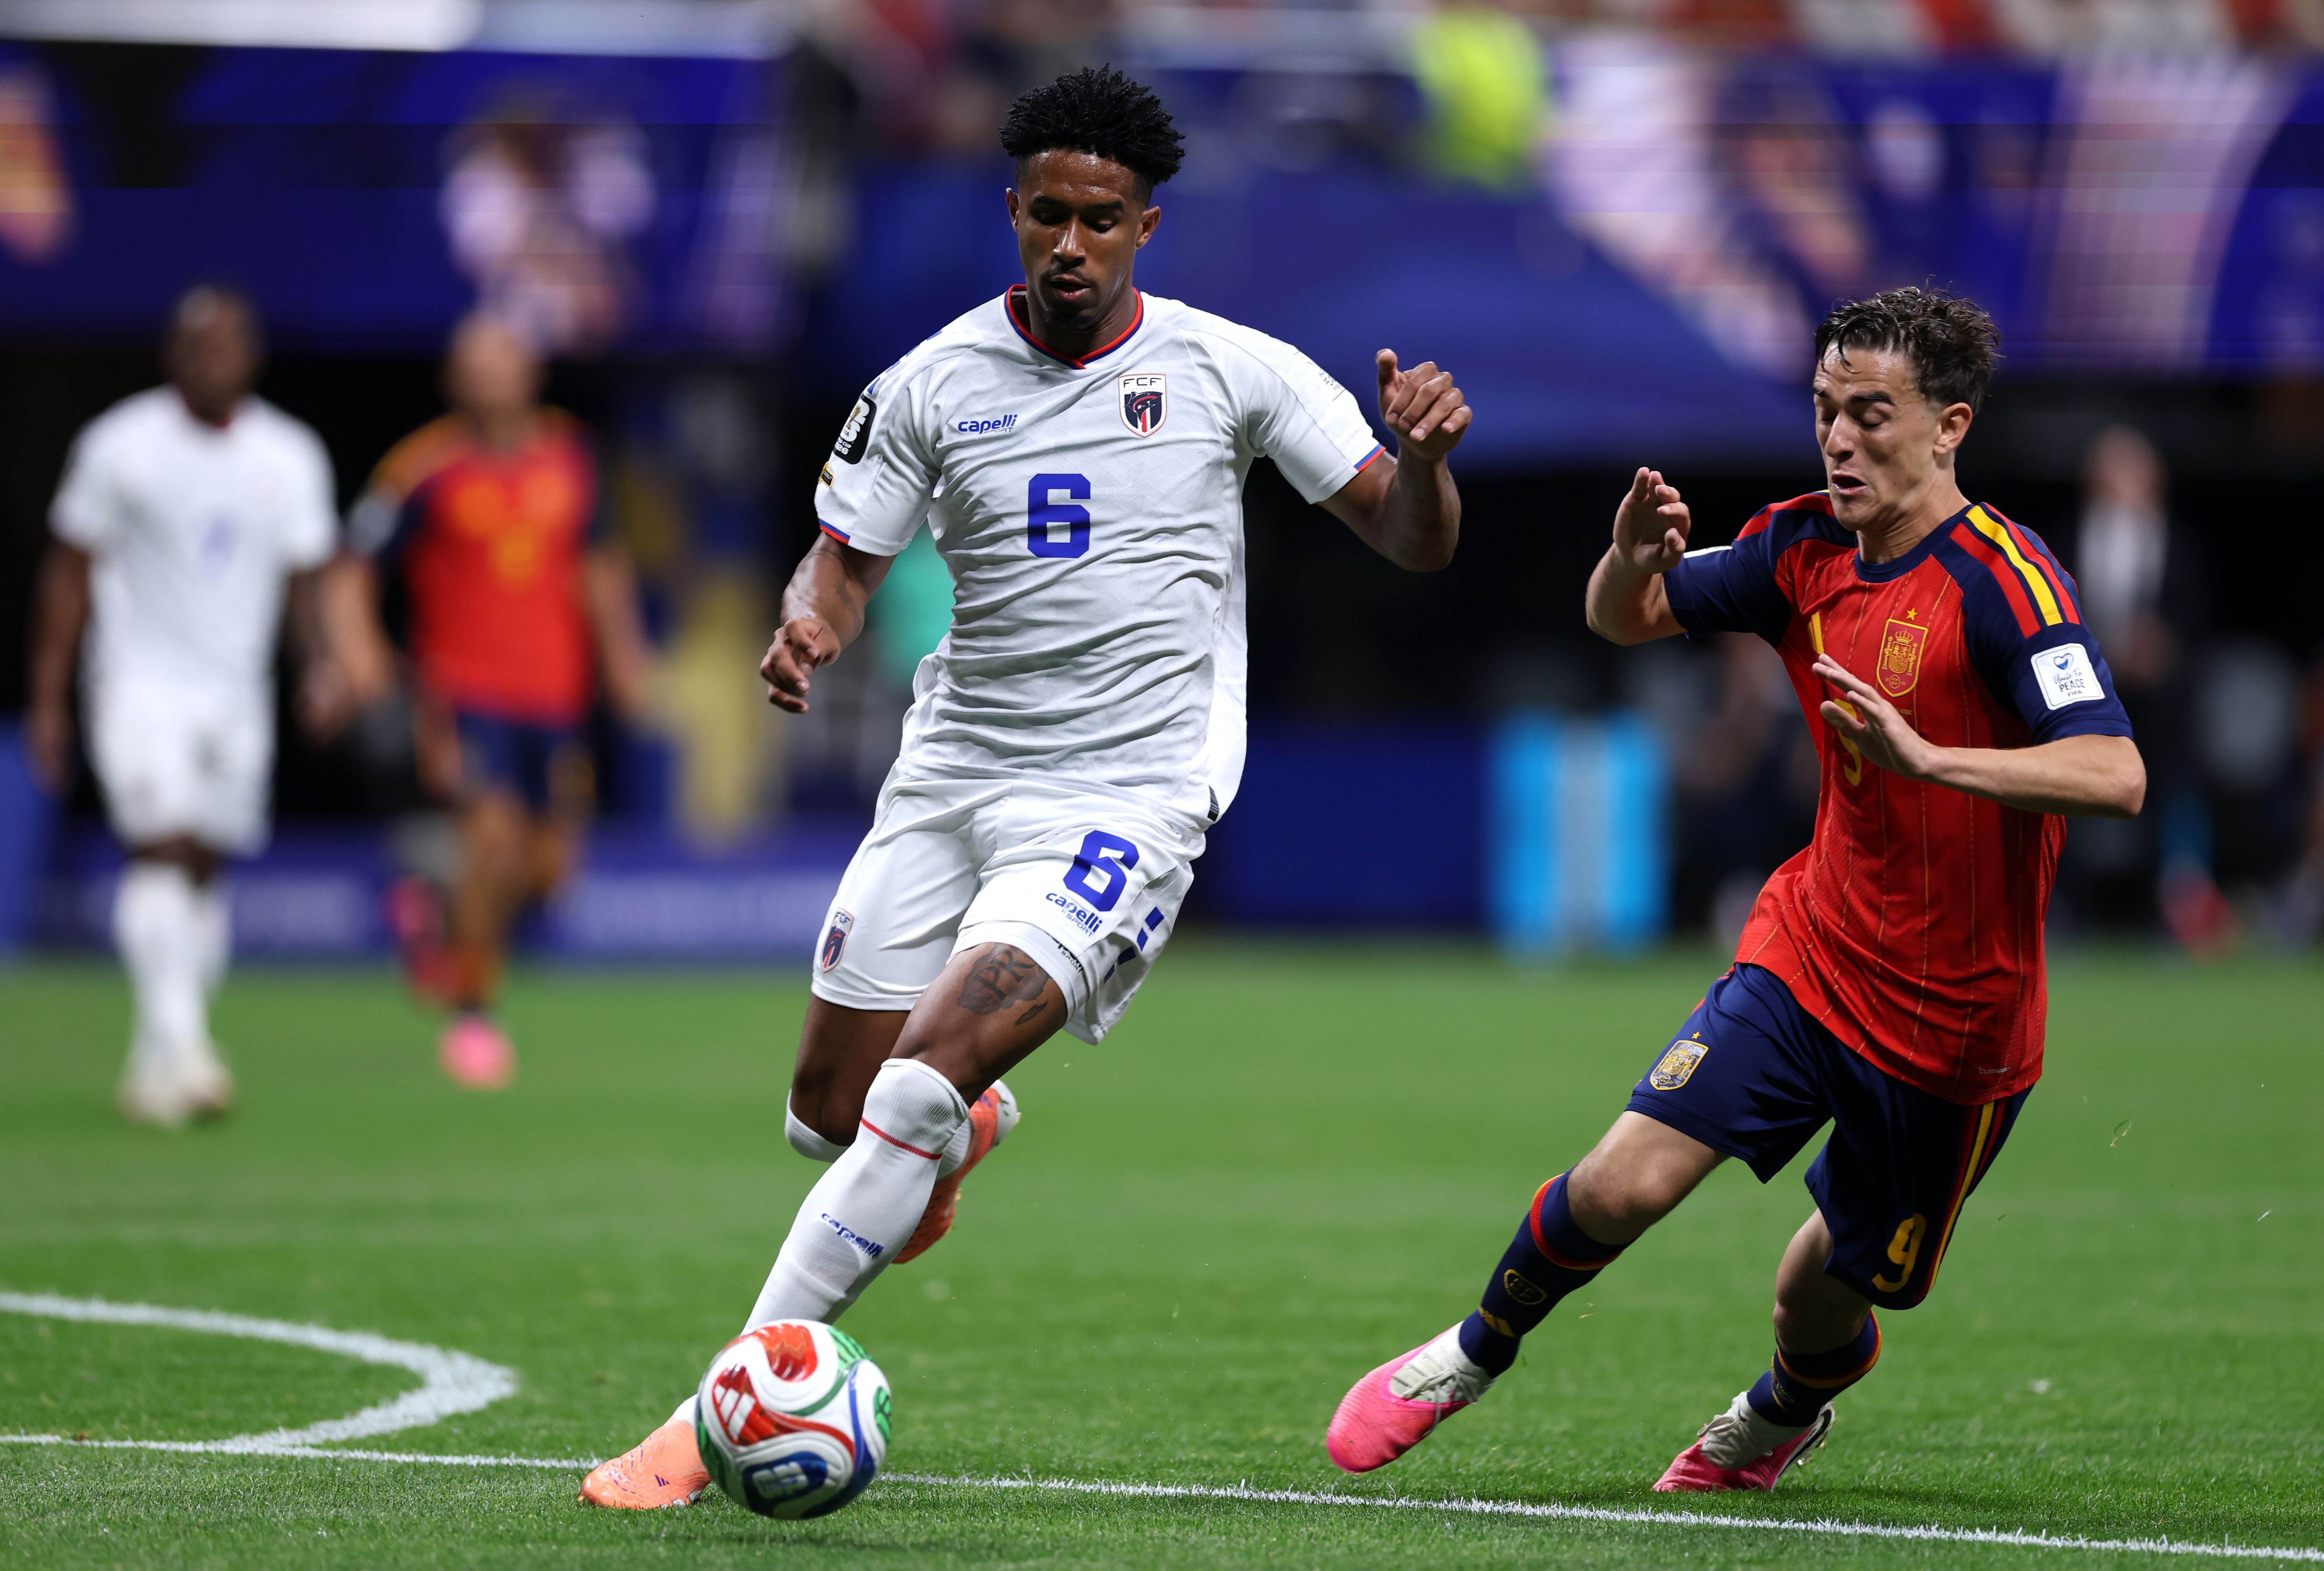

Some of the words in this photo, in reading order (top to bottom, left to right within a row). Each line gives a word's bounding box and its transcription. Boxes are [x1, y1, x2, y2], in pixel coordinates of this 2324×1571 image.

[1123, 377, 1161, 388] FCF
[958, 414, 1018, 434] capelli
[1028, 473, 1090, 558] 6
[2059, 679, 2085, 692] PEACE
[1064, 830, 1139, 911] 6
[834, 912, 851, 924] FCF
[1046, 893, 1102, 933] capelli
[1871, 1212, 1926, 1292] 9
